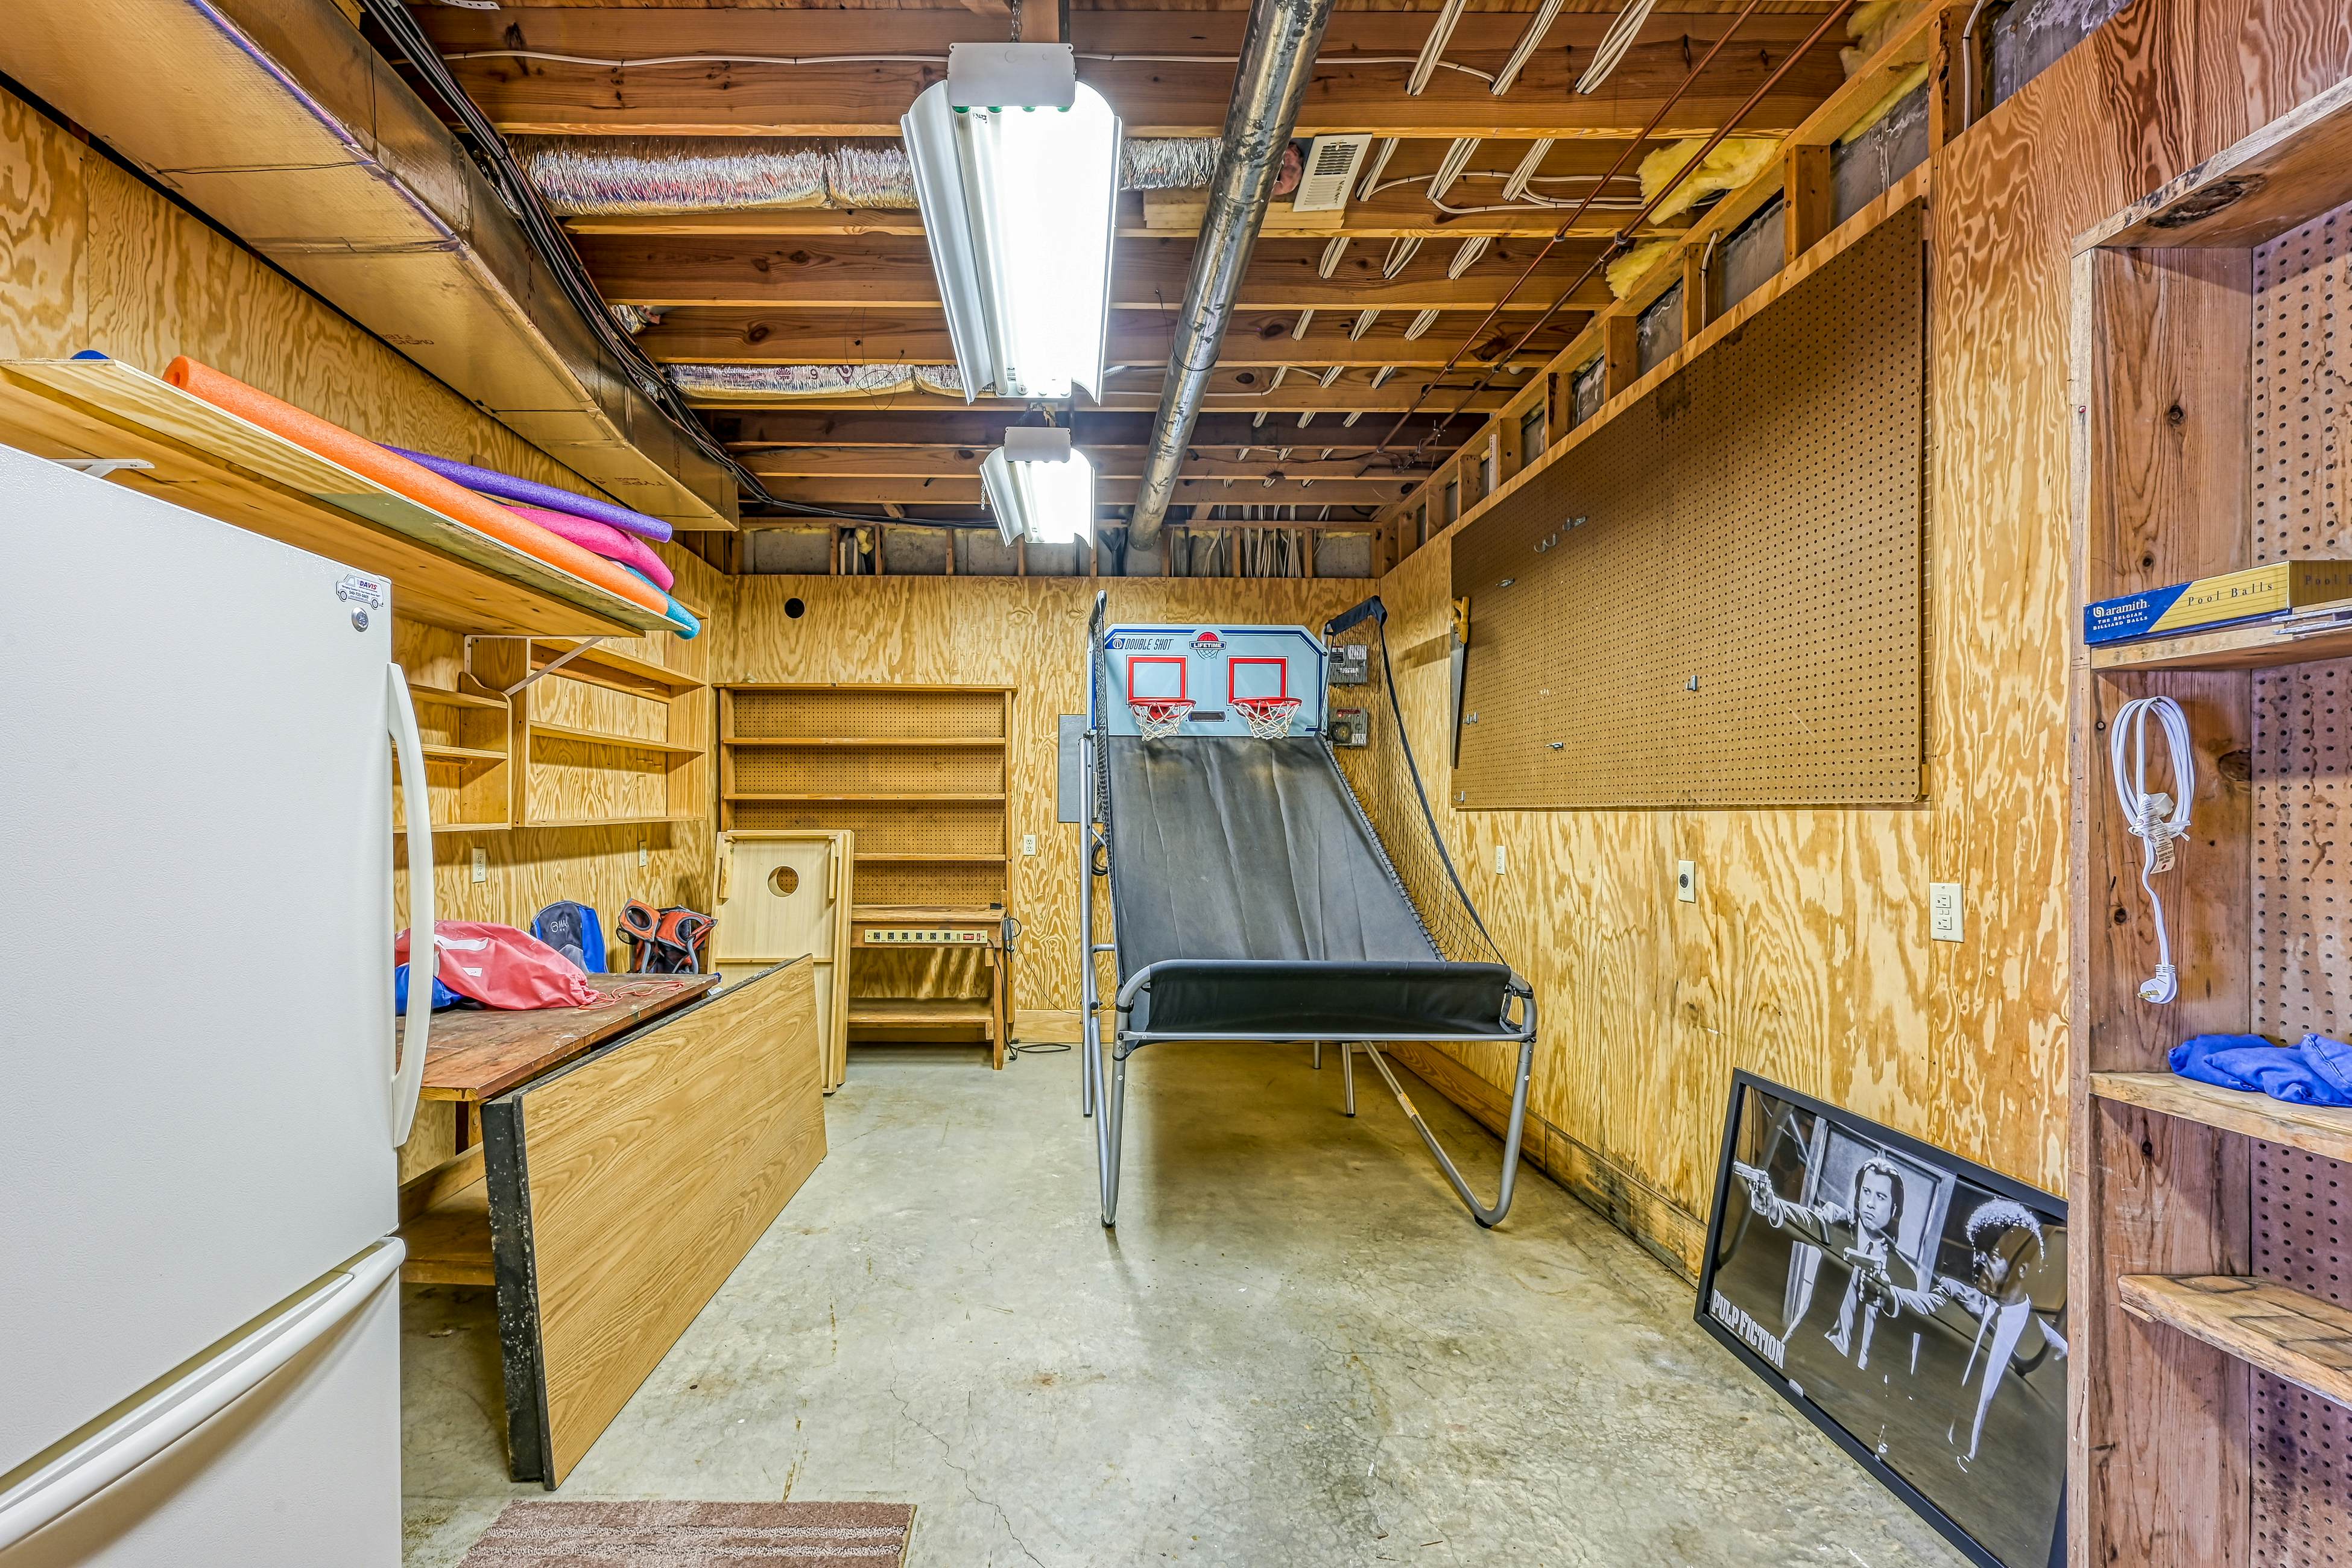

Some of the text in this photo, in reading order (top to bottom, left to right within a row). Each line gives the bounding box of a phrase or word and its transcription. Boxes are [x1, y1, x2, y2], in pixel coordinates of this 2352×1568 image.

[359, 580, 378, 590] DAVIS
[2305, 574, 2338, 586] Pool
[2187, 582, 2272, 607] Pool Balls
[2113, 612, 2143, 621] BELGIAN
[2093, 616, 2148, 631] BILLIARD BALLS
[1125, 638, 1174, 650] DOUBLE SHOT
[1711, 1288, 1740, 1329] PULP
[1738, 1309, 1786, 1370] FICTION
